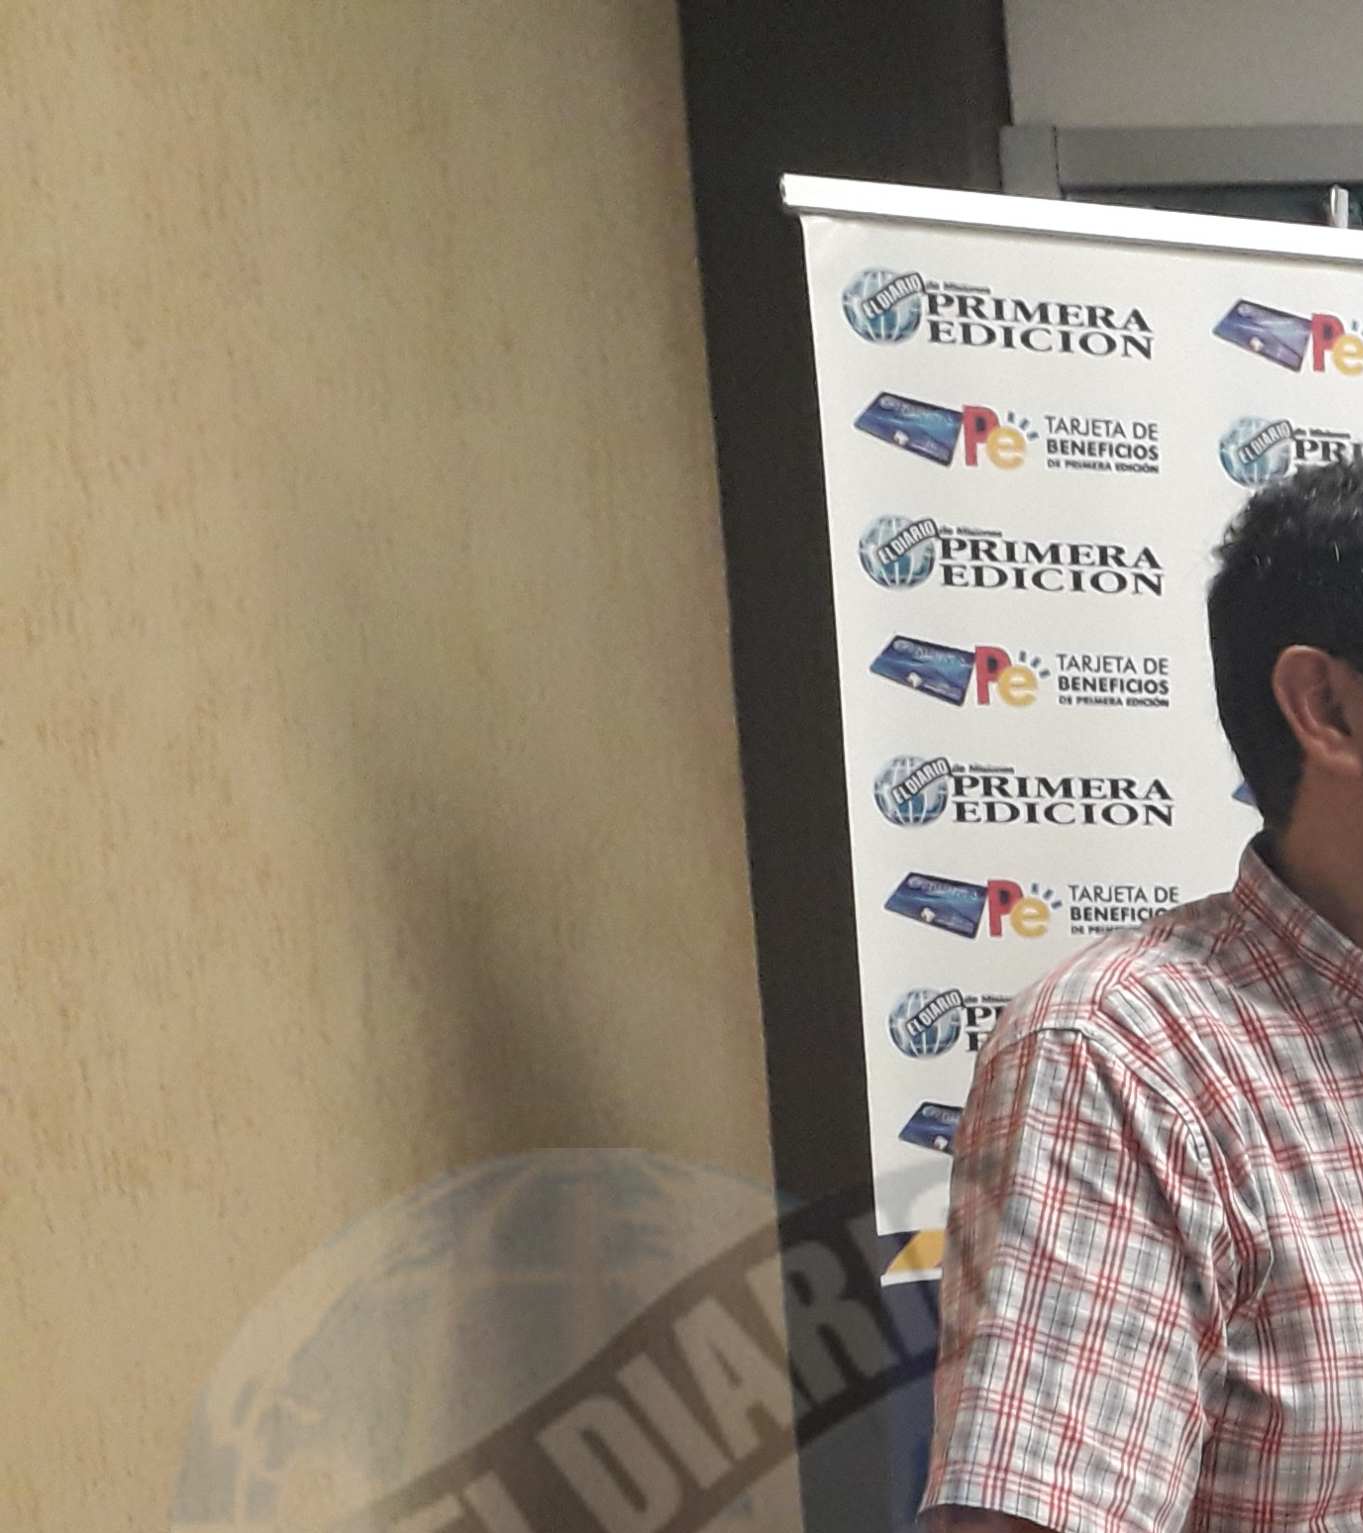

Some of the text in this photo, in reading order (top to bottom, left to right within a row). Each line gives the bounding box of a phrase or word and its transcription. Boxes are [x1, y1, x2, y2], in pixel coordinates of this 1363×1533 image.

[862, 296, 885, 320] EL
[880, 273, 922, 311] DIARIO
[926, 292, 1153, 334] PRIMERA
[926, 320, 1154, 360] EDICION
[961, 404, 1027, 471] Pe
[1045, 415, 1159, 442] TARJETA DE
[1239, 443, 1255, 464] EL
[1252, 420, 1291, 457] DIARIO
[1047, 438, 1160, 462] BENEFICIOS
[1047, 458, 1062, 469] DE
[877, 519, 937, 566] EL DIARIO
[938, 538, 1163, 570] PRIMERA
[939, 563, 1164, 597] EDICION
[973, 644, 1039, 708] Pe
[1057, 653, 1170, 676] TARJETA DE
[1058, 676, 1170, 697] BENEFICIOS
[1058, 694, 1073, 706] DE
[891, 757, 949, 806] EL DIARIO
[951, 776, 1174, 801] PRIMERA
[953, 801, 1174, 828] EDICION
[986, 878, 1051, 939] Pe
[1068, 884, 1180, 903] TARJETA DE
[1070, 905, 1168, 923] BENEFICI
[906, 990, 961, 1036] EL DIARIO
